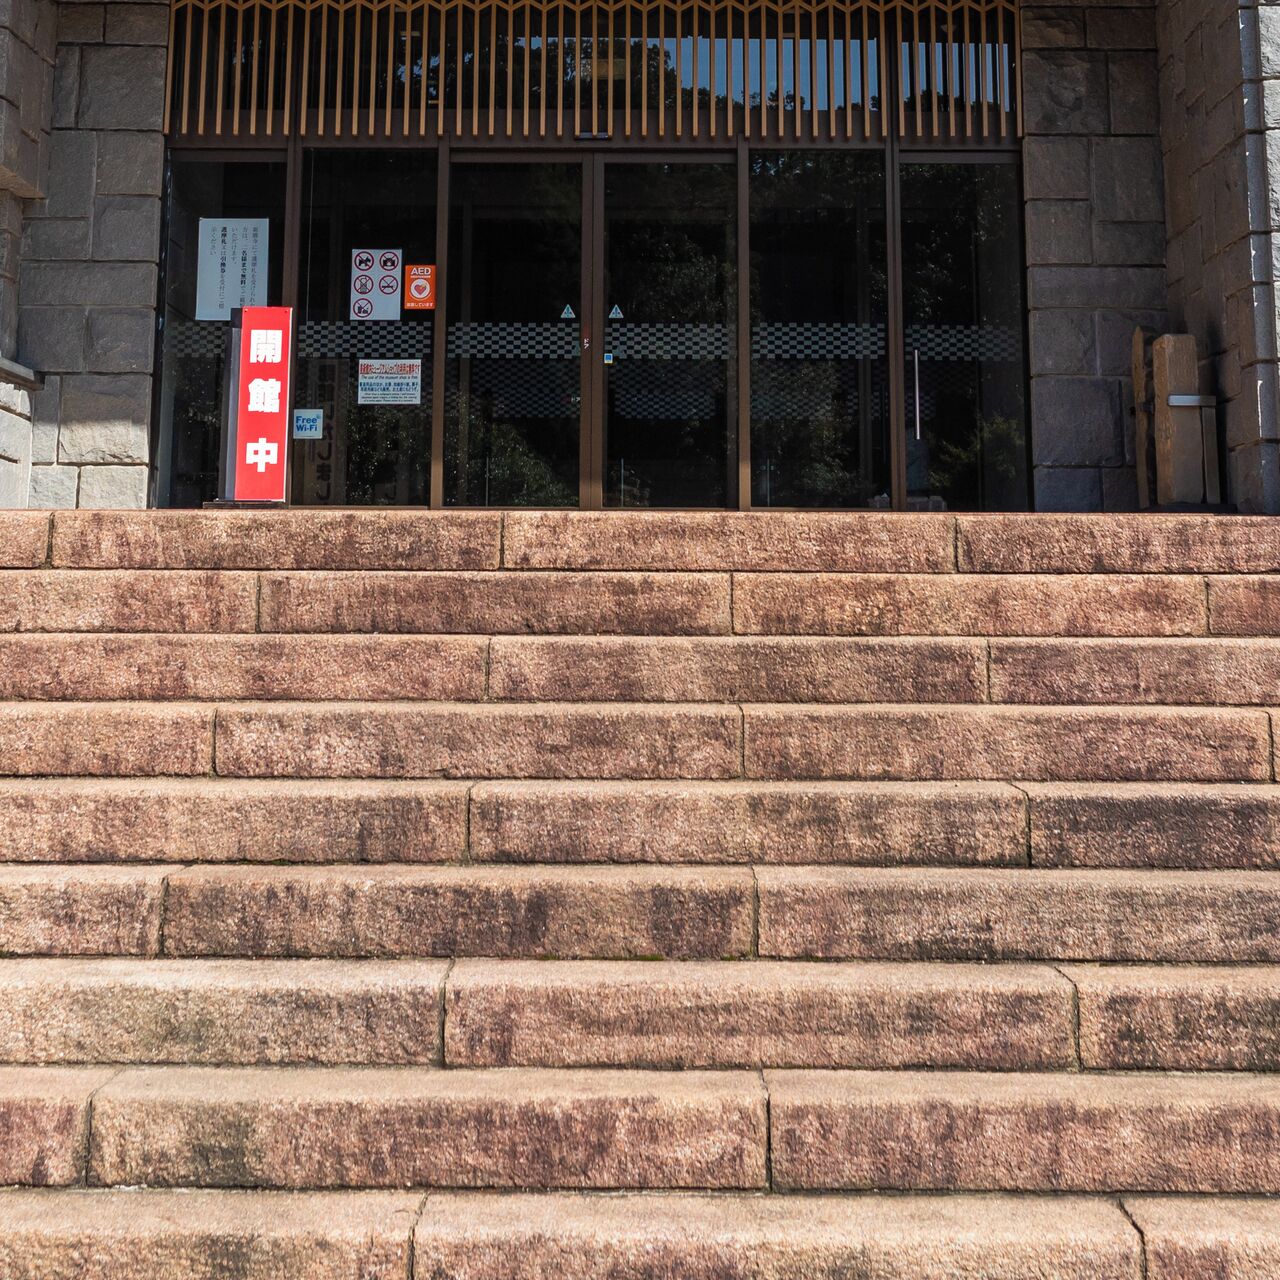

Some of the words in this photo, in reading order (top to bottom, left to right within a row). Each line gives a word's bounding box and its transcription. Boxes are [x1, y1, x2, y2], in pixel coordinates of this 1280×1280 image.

[410, 267, 432, 275] AED
[245, 329, 283, 473] 開館中
[295, 416, 317, 424] Free
[295, 424, 318, 432] Wi-Fi
